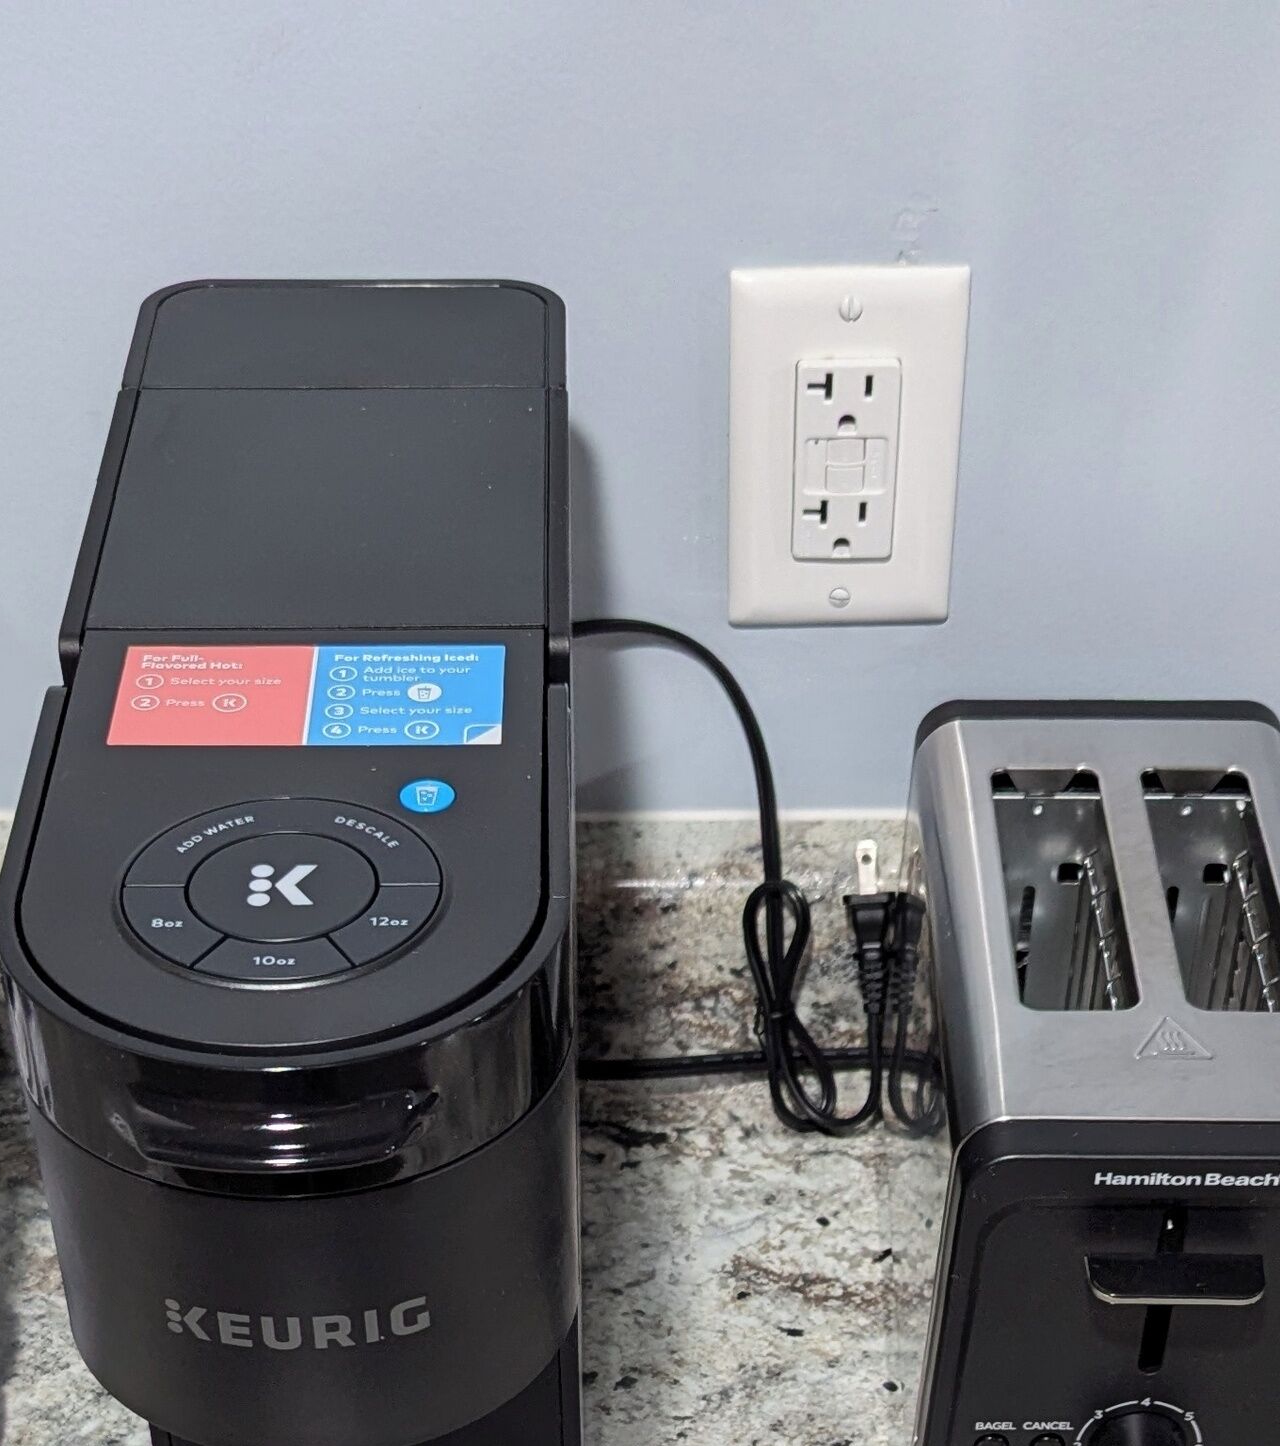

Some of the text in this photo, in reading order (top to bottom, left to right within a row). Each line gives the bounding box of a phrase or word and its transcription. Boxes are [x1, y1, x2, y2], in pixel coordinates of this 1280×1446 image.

[362, 654, 440, 663] Refreshing
[445, 654, 479, 662] Iced:
[142, 662, 243, 670] Flavored Hot:
[339, 670, 346, 678] 1
[440, 667, 471, 675] your
[171, 677, 214, 685] Select
[255, 677, 281, 685] size
[140, 699, 151, 707] 2
[166, 699, 205, 707] Press
[334, 707, 344, 715] 3
[410, 708, 441, 716] your
[331, 726, 342, 734] 4
[176, 815, 256, 854] ADD WATER
[334, 815, 400, 849] DESCALE
[151, 918, 183, 928] 8oz
[369, 916, 408, 927] 12oz
[253, 956, 296, 966] 10oz
[1094, 1172, 1280, 1186] Hamilton Beach
[164, 1295, 431, 1350] KEURIG
[1140, 1398, 1151, 1406] 4
[1094, 1410, 1104, 1419] 3
[1184, 1412, 1194, 1421] 5
[975, 1422, 1074, 1430] BAGEL CANCEL
